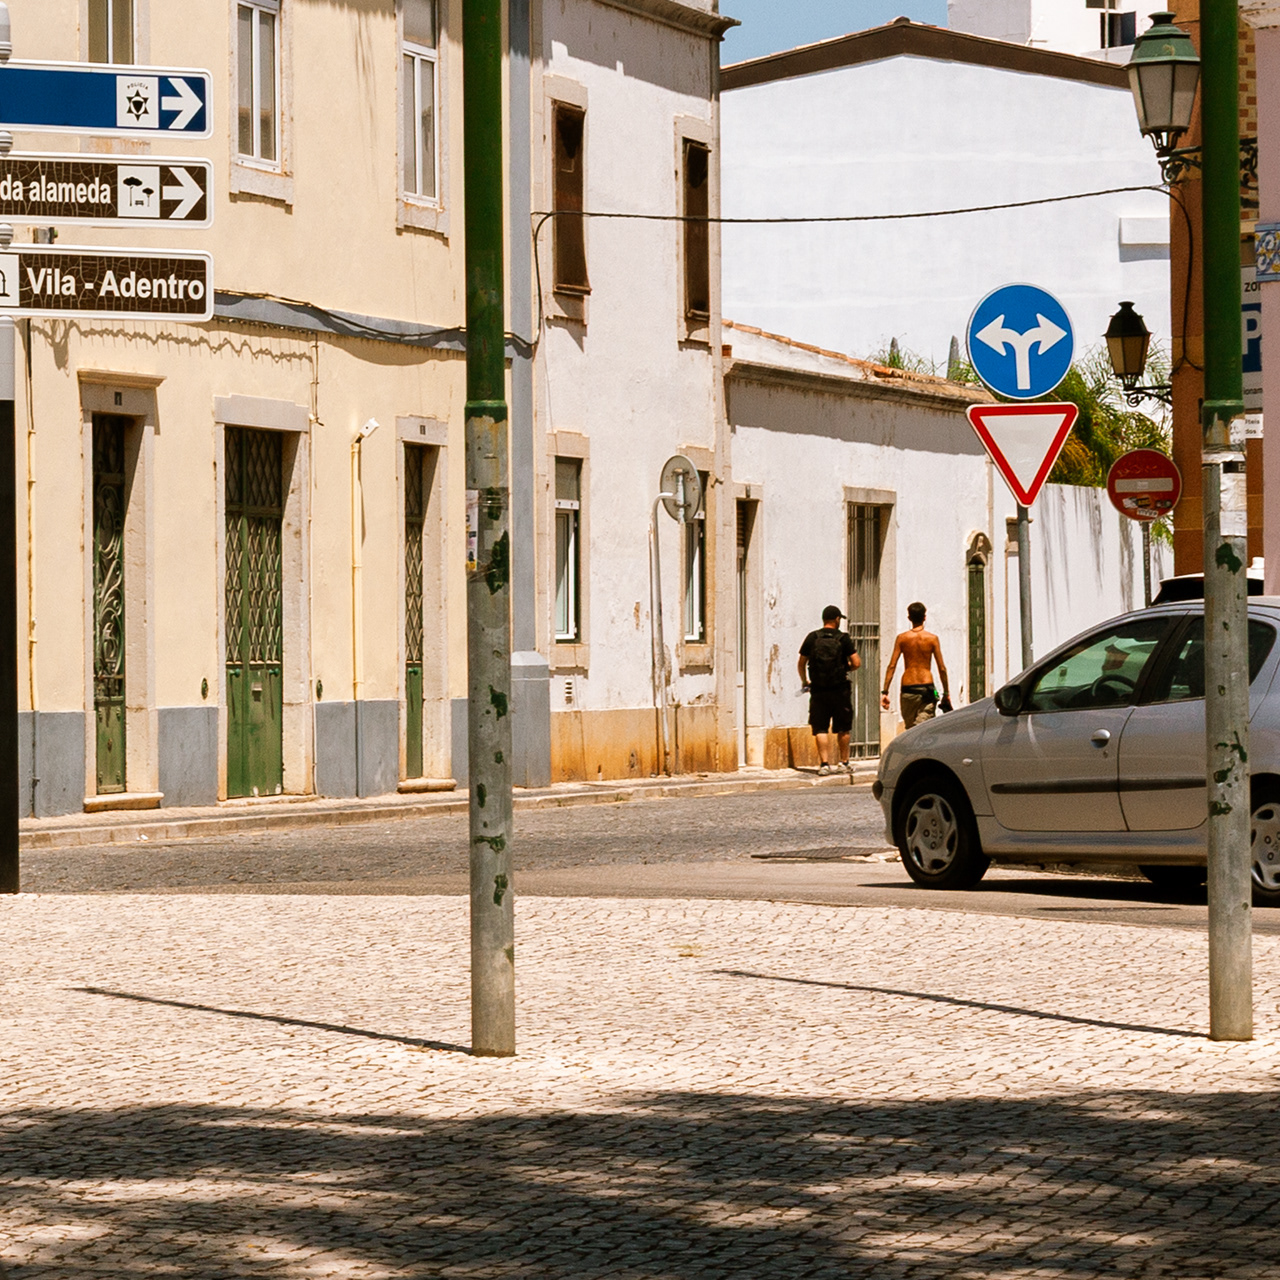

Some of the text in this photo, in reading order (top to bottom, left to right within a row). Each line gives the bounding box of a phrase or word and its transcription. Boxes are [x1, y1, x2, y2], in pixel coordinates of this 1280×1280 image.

[0, 175, 24, 202] da
[29, 177, 112, 204] alameda
[26, 267, 77, 297] Vila
[99, 270, 205, 300] Adentro
